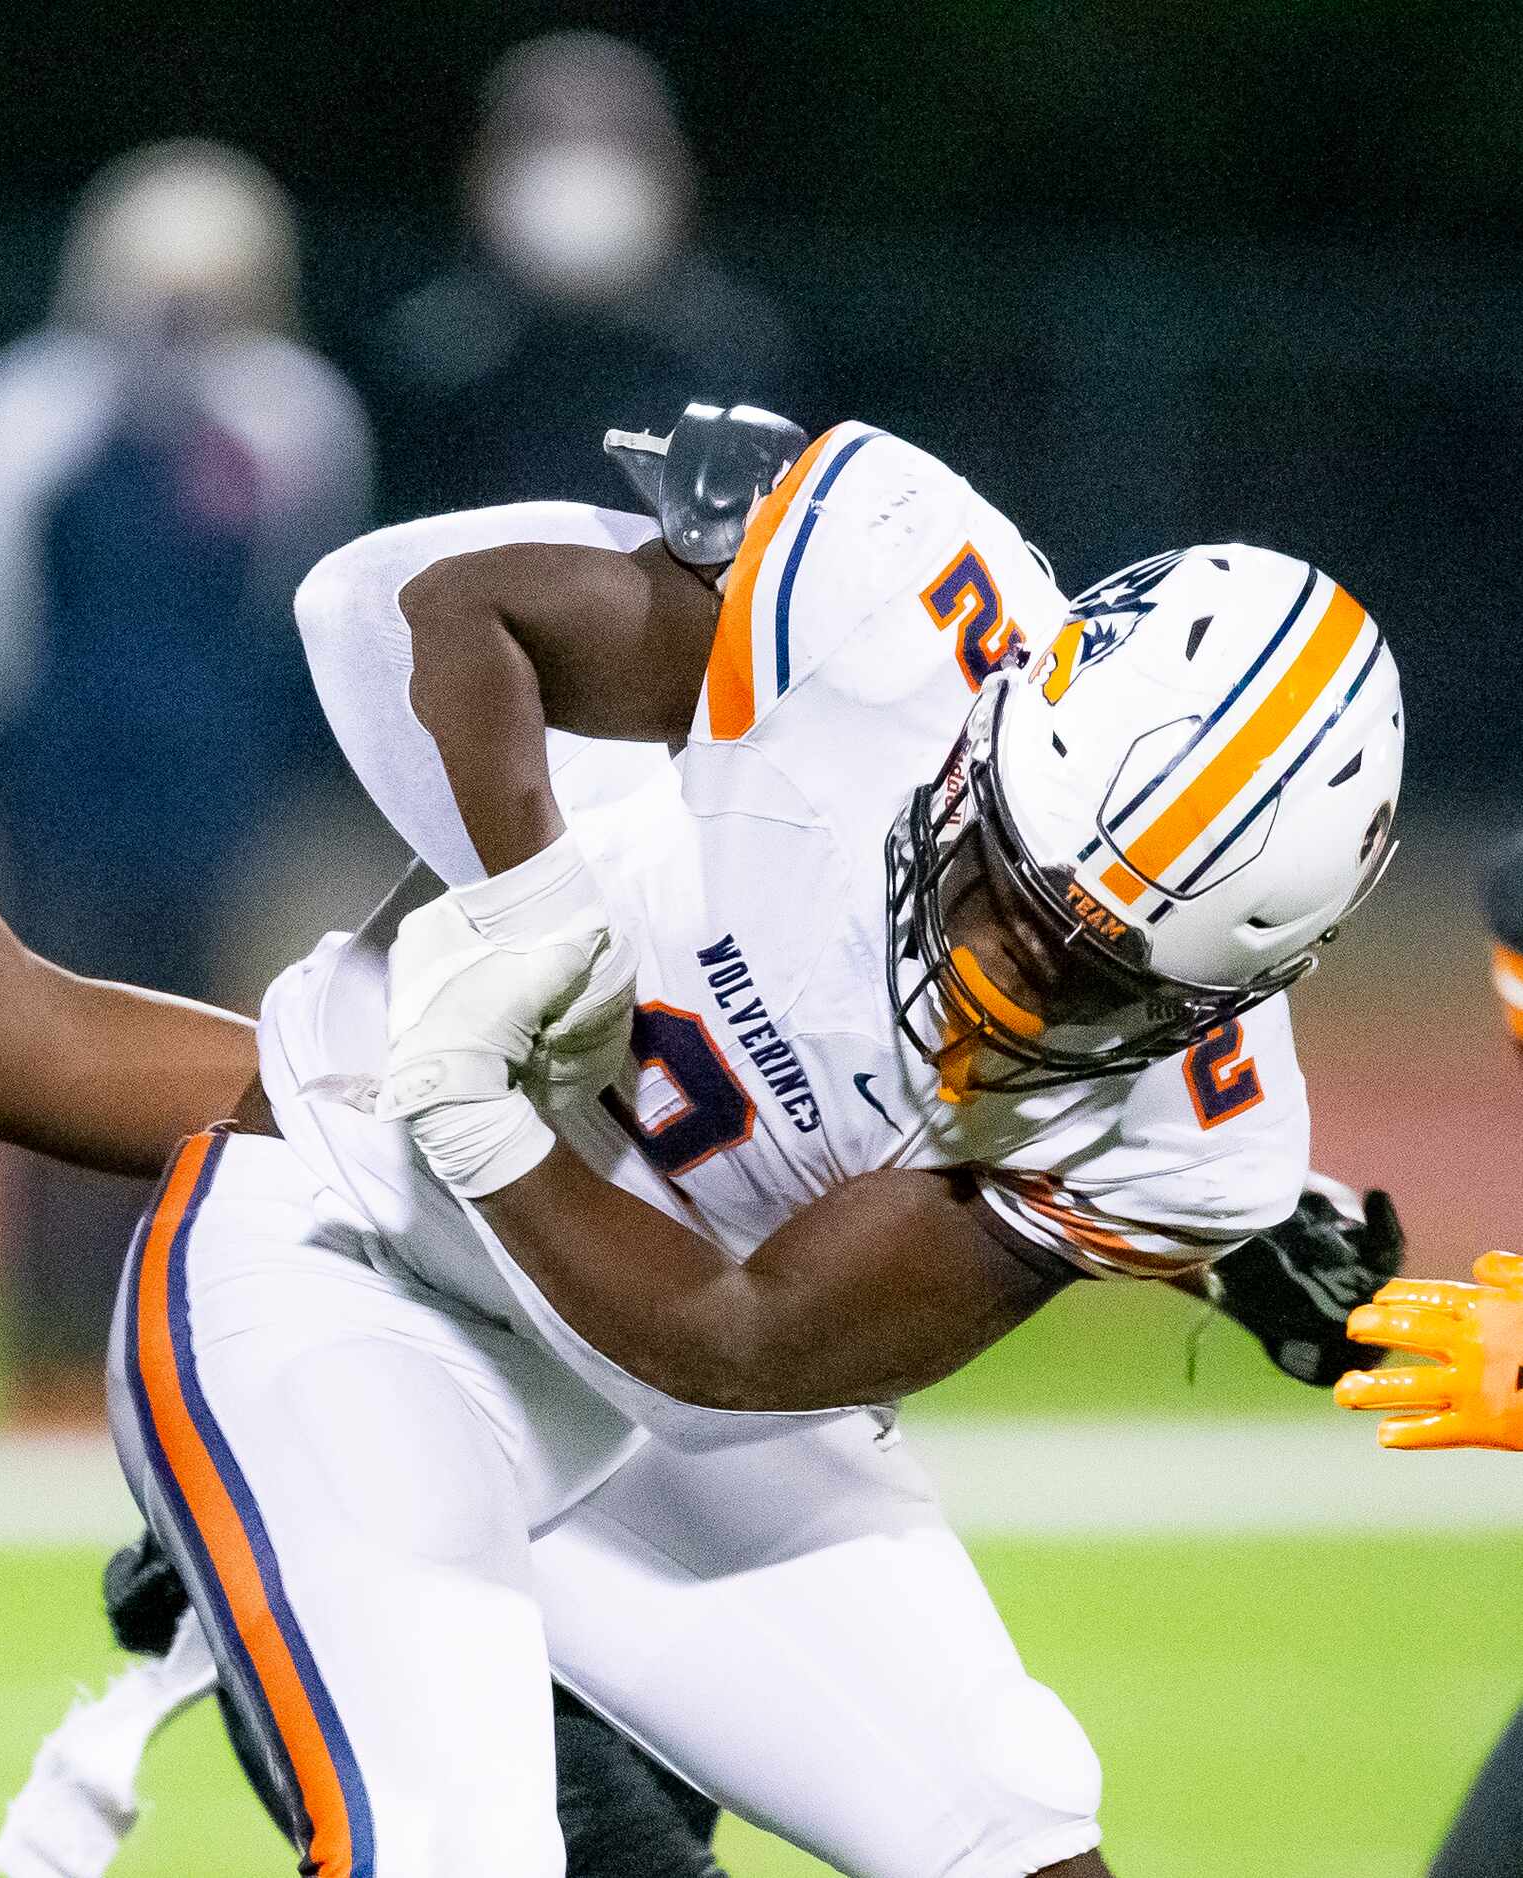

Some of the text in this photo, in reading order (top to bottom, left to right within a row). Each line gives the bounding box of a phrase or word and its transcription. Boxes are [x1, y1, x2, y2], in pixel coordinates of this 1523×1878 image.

[919, 540, 1027, 694] 2
[1067, 883, 1128, 941] TEAM
[696, 933, 820, 1134] WOLVERINES
[1182, 1016, 1265, 1131] 2
